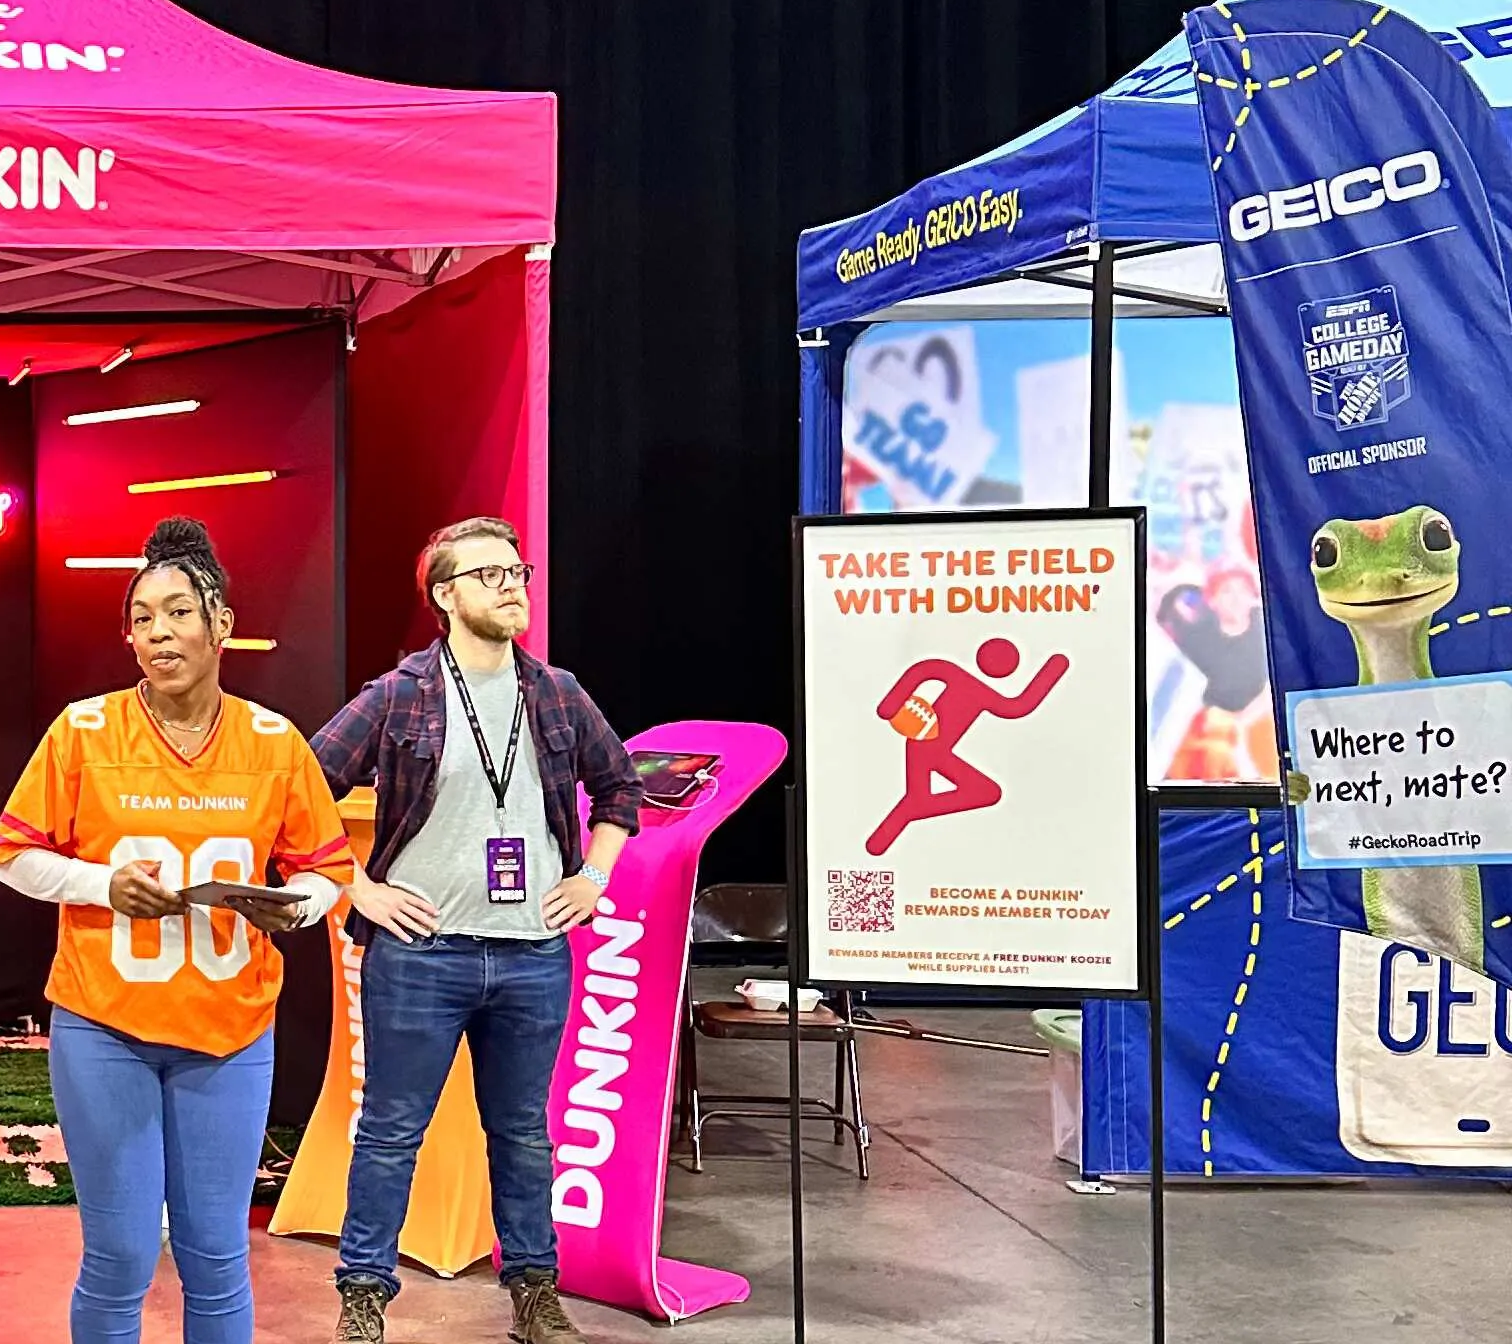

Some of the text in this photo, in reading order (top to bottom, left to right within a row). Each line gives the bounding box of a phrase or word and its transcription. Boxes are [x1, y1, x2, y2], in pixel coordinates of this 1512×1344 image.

[1228, 149, 1442, 244] GEICO
[836, 188, 1023, 284] Game Ready. GEICO Easy.
[1325, 300, 1371, 318] ESPN
[1311, 312, 1391, 344] COLLEGE
[1306, 331, 1404, 372] GAMEDAY
[1338, 371, 1382, 425] HOME
[1308, 436, 1427, 474] OFFICIAL SPONSOR
[819, 548, 1115, 580] TAKE THE FIELD
[834, 583, 1100, 615] WITH DUNKIN'
[1310, 719, 1455, 760] Where to
[1316, 762, 1503, 809] next, mate?
[119, 794, 248, 811] TEAM DUNKIN'
[1347, 832, 1482, 852] #GeckoRoadTrip
[930, 887, 1084, 902] BECOME A DUNKIN'
[903, 904, 1111, 920] REWARDS MEMBER TODAY
[828, 948, 879, 959] REWARDS
[881, 949, 933, 960] MEMBERS
[935, 952, 980, 961] RECEIVE
[993, 954, 1019, 962] FREE
[1071, 956, 1112, 965] KOOZIE
[908, 962, 943, 972] WHILE
[945, 963, 996, 973] SUPPLIES
[551, 895, 641, 1229] DUNKIN'
